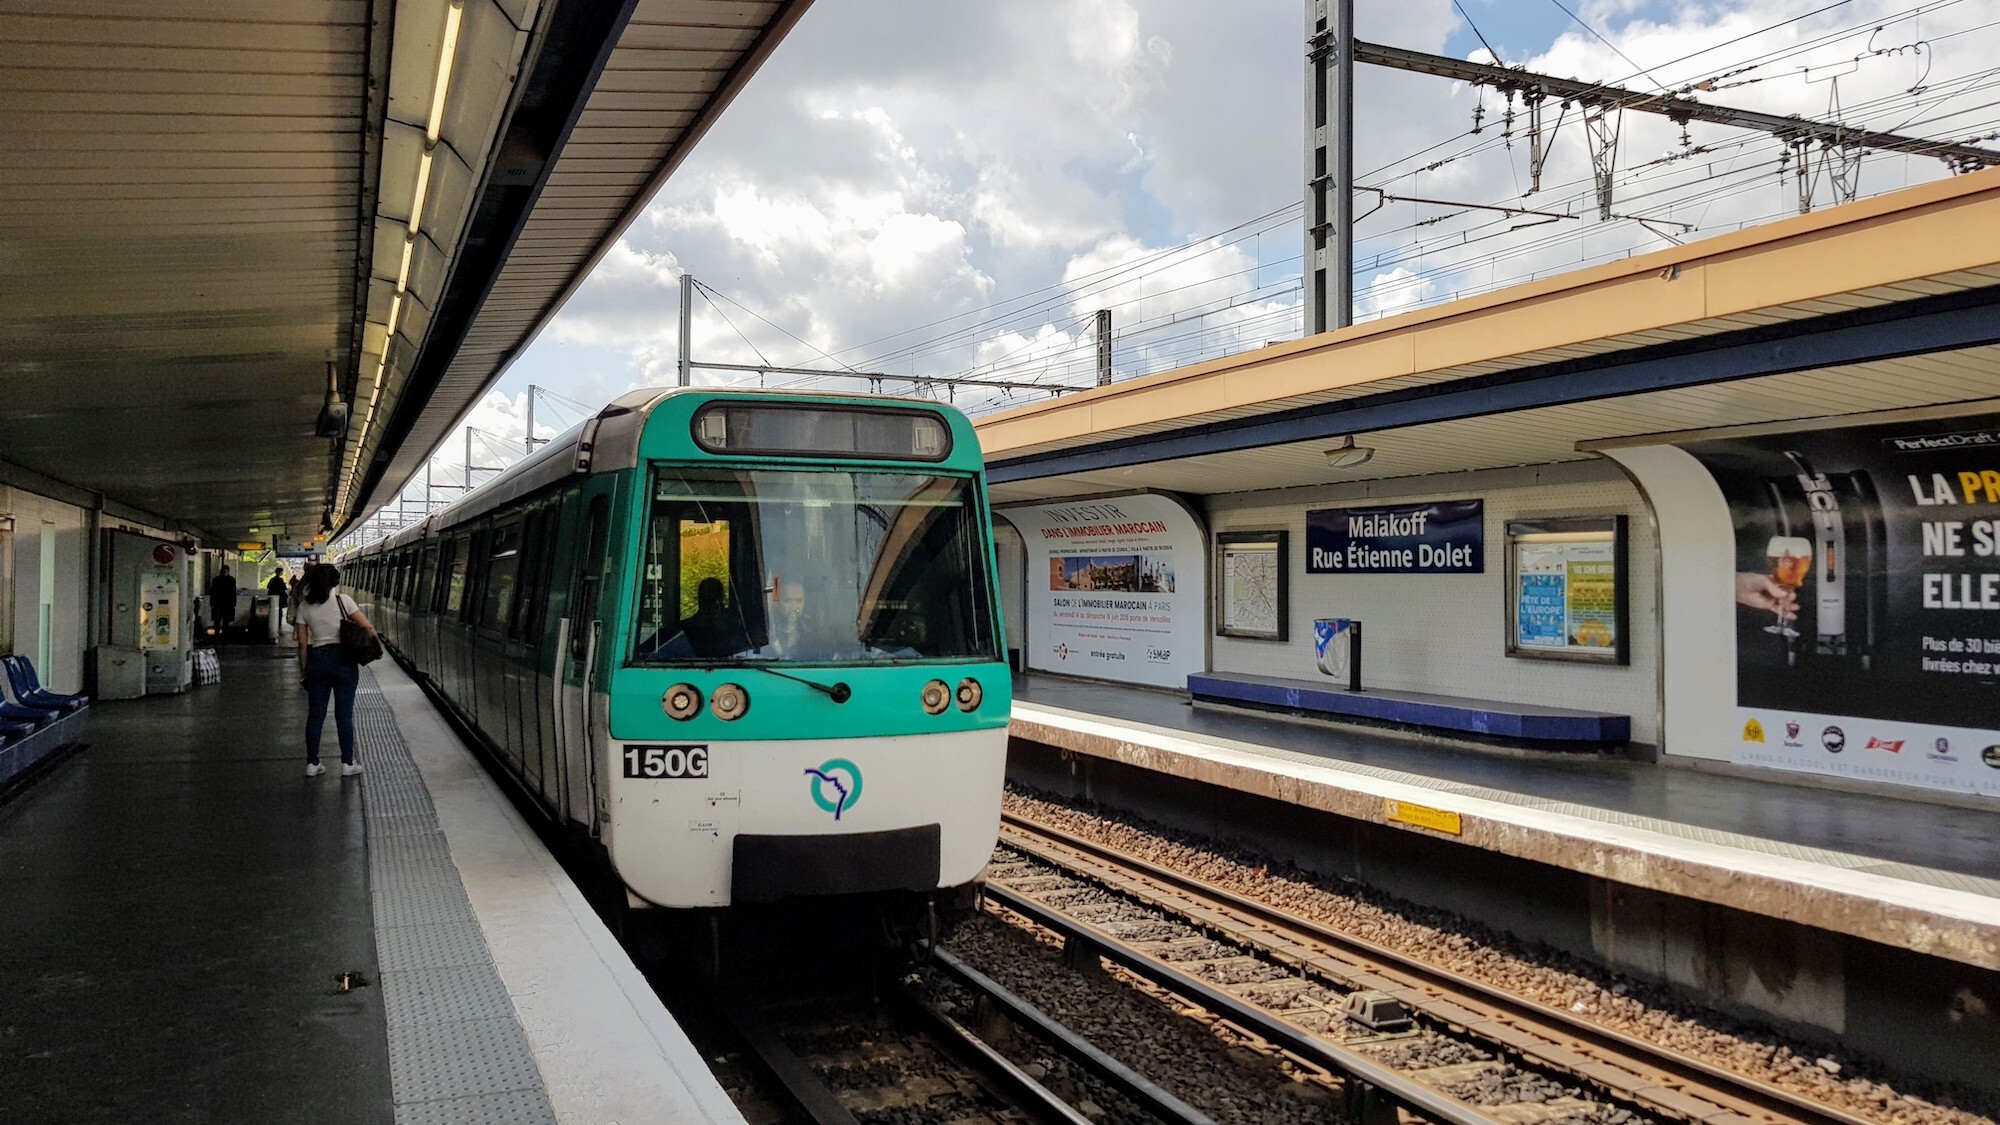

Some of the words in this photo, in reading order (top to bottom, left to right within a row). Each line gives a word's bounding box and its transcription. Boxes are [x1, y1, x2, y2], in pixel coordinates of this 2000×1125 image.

[1894, 433, 1996, 450] PerfectDraft
[1907, 473, 1958, 505] LA
[1043, 504, 1127, 523] INVESTIR
[1041, 527, 1064, 539] DANS
[1063, 524, 1114, 538] L'IMMOBILIER
[1113, 520, 1168, 535] MAROCAIN
[1348, 511, 1428, 538] Malakoff
[1921, 522, 1966, 556] NE
[1312, 547, 1343, 568] Rue
[1347, 541, 1413, 568] Étienne
[1418, 542, 1473, 568] Dolet
[1520, 595, 1540, 604] FÊTE
[1923, 574, 2000, 610] ELLE
[1053, 598, 1070, 607] SALON
[1078, 598, 1113, 609] L'IMMOBILIER
[1114, 601, 1147, 610] MAROCAIN
[1148, 600, 1153, 610] À
[1154, 602, 1171, 611] PARIS
[1086, 612, 1106, 620] dimanche
[1110, 613, 1119, 622] juin
[1130, 615, 1141, 623] porte
[1149, 615, 1171, 623] Versailles
[1921, 636, 1947, 652] Plus
[1948, 638, 1964, 652] de
[1965, 638, 1982, 653] 30
[1106, 651, 1126, 661] gratuite
[1922, 656, 1962, 673] livrées
[1962, 659, 1992, 675] chez
[624, 748, 708, 777] 150G
